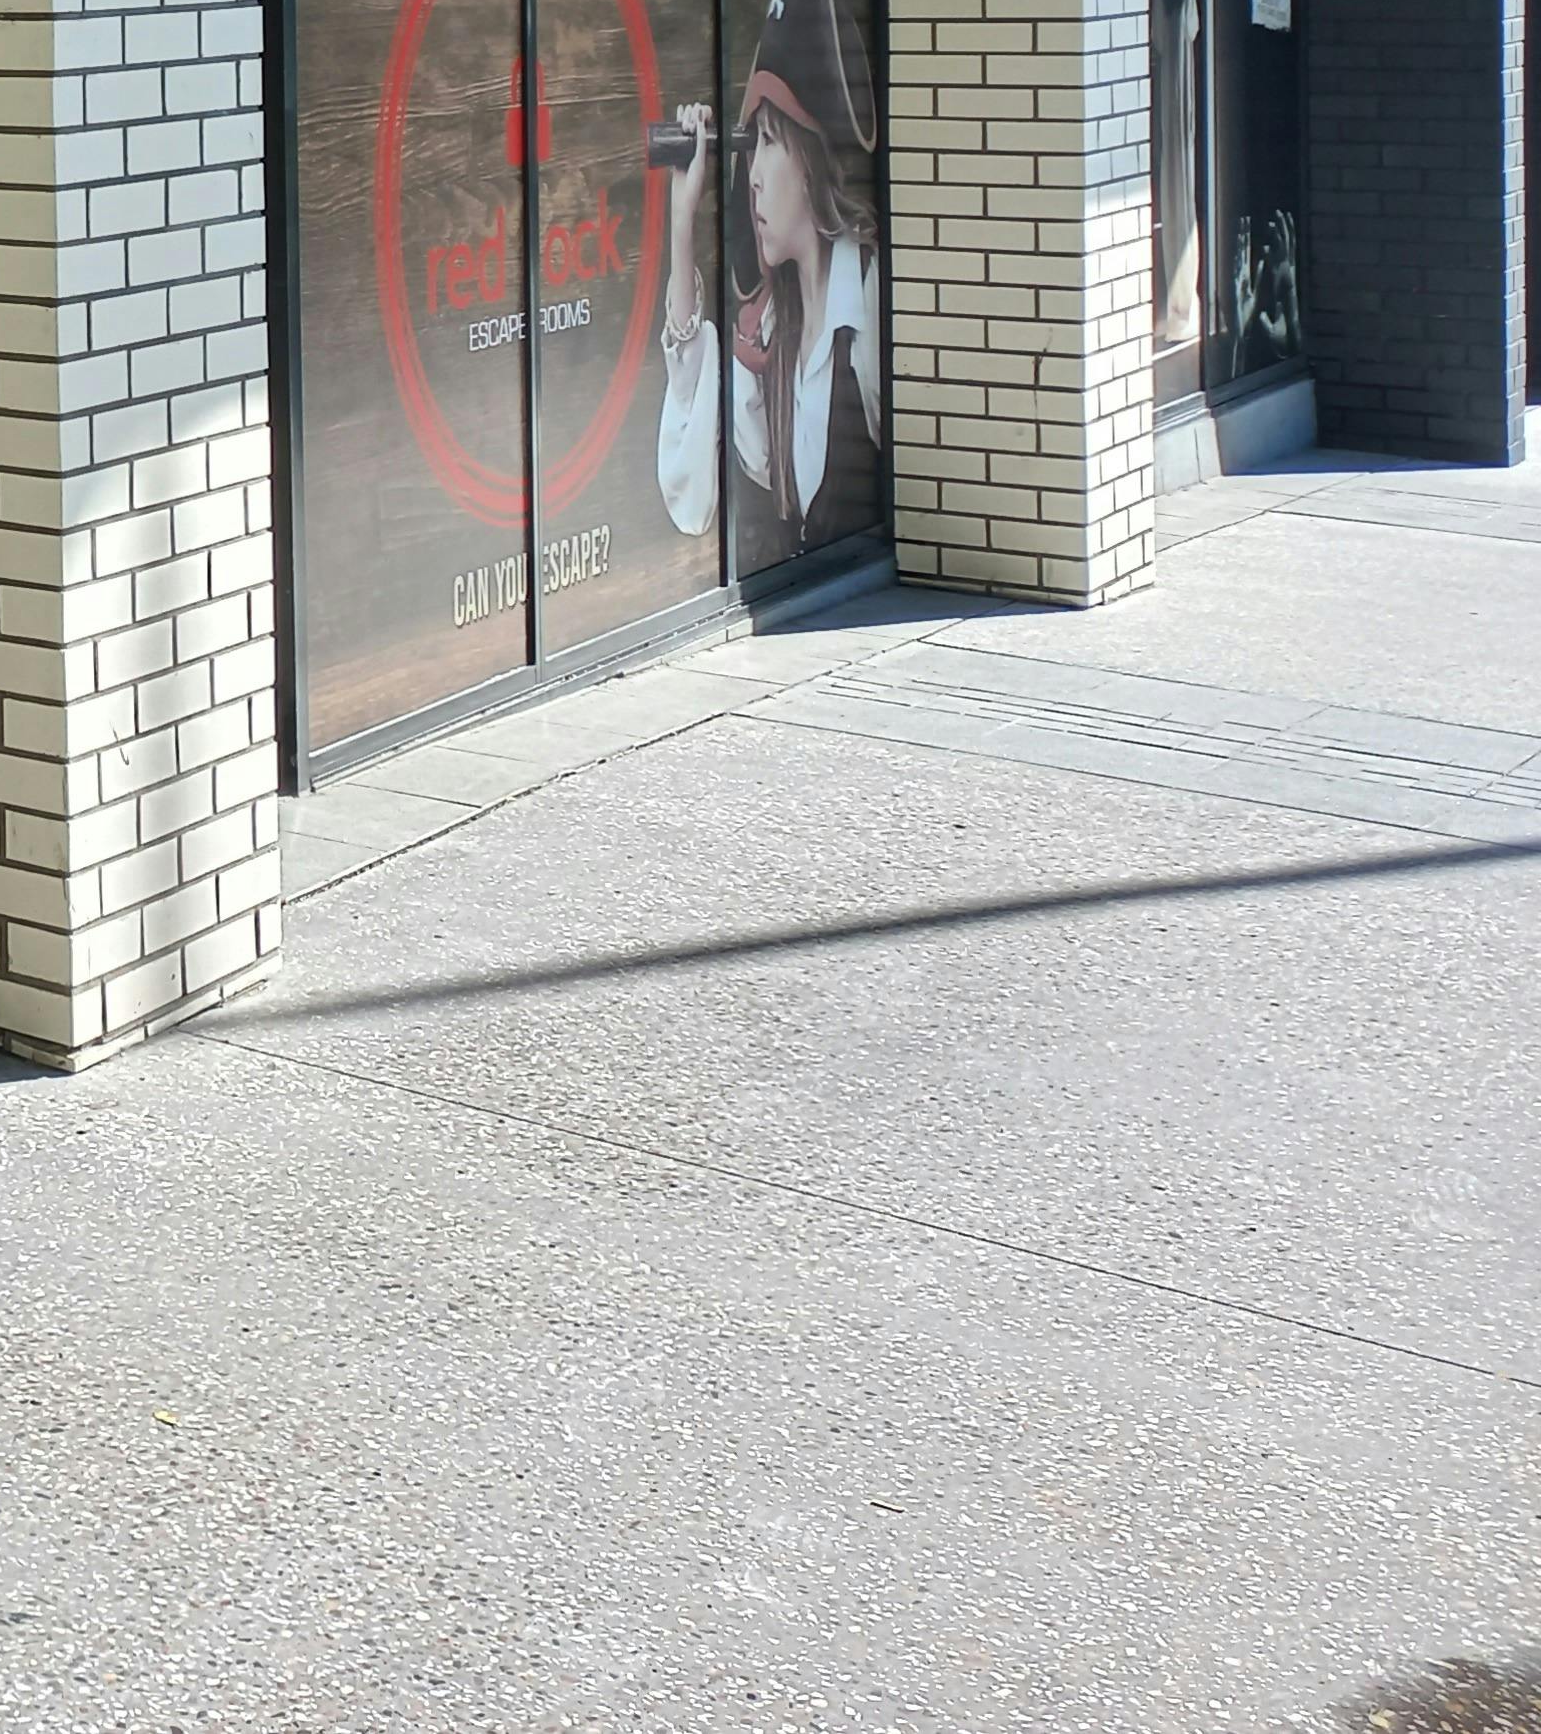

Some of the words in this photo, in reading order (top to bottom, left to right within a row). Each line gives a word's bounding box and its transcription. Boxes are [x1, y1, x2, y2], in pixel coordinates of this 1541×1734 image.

[427, 206, 506, 314] red
[542, 186, 625, 287] ock
[468, 311, 527, 352] ESCAPE
[453, 566, 490, 628] CAN
[494, 552, 528, 611] YOU
